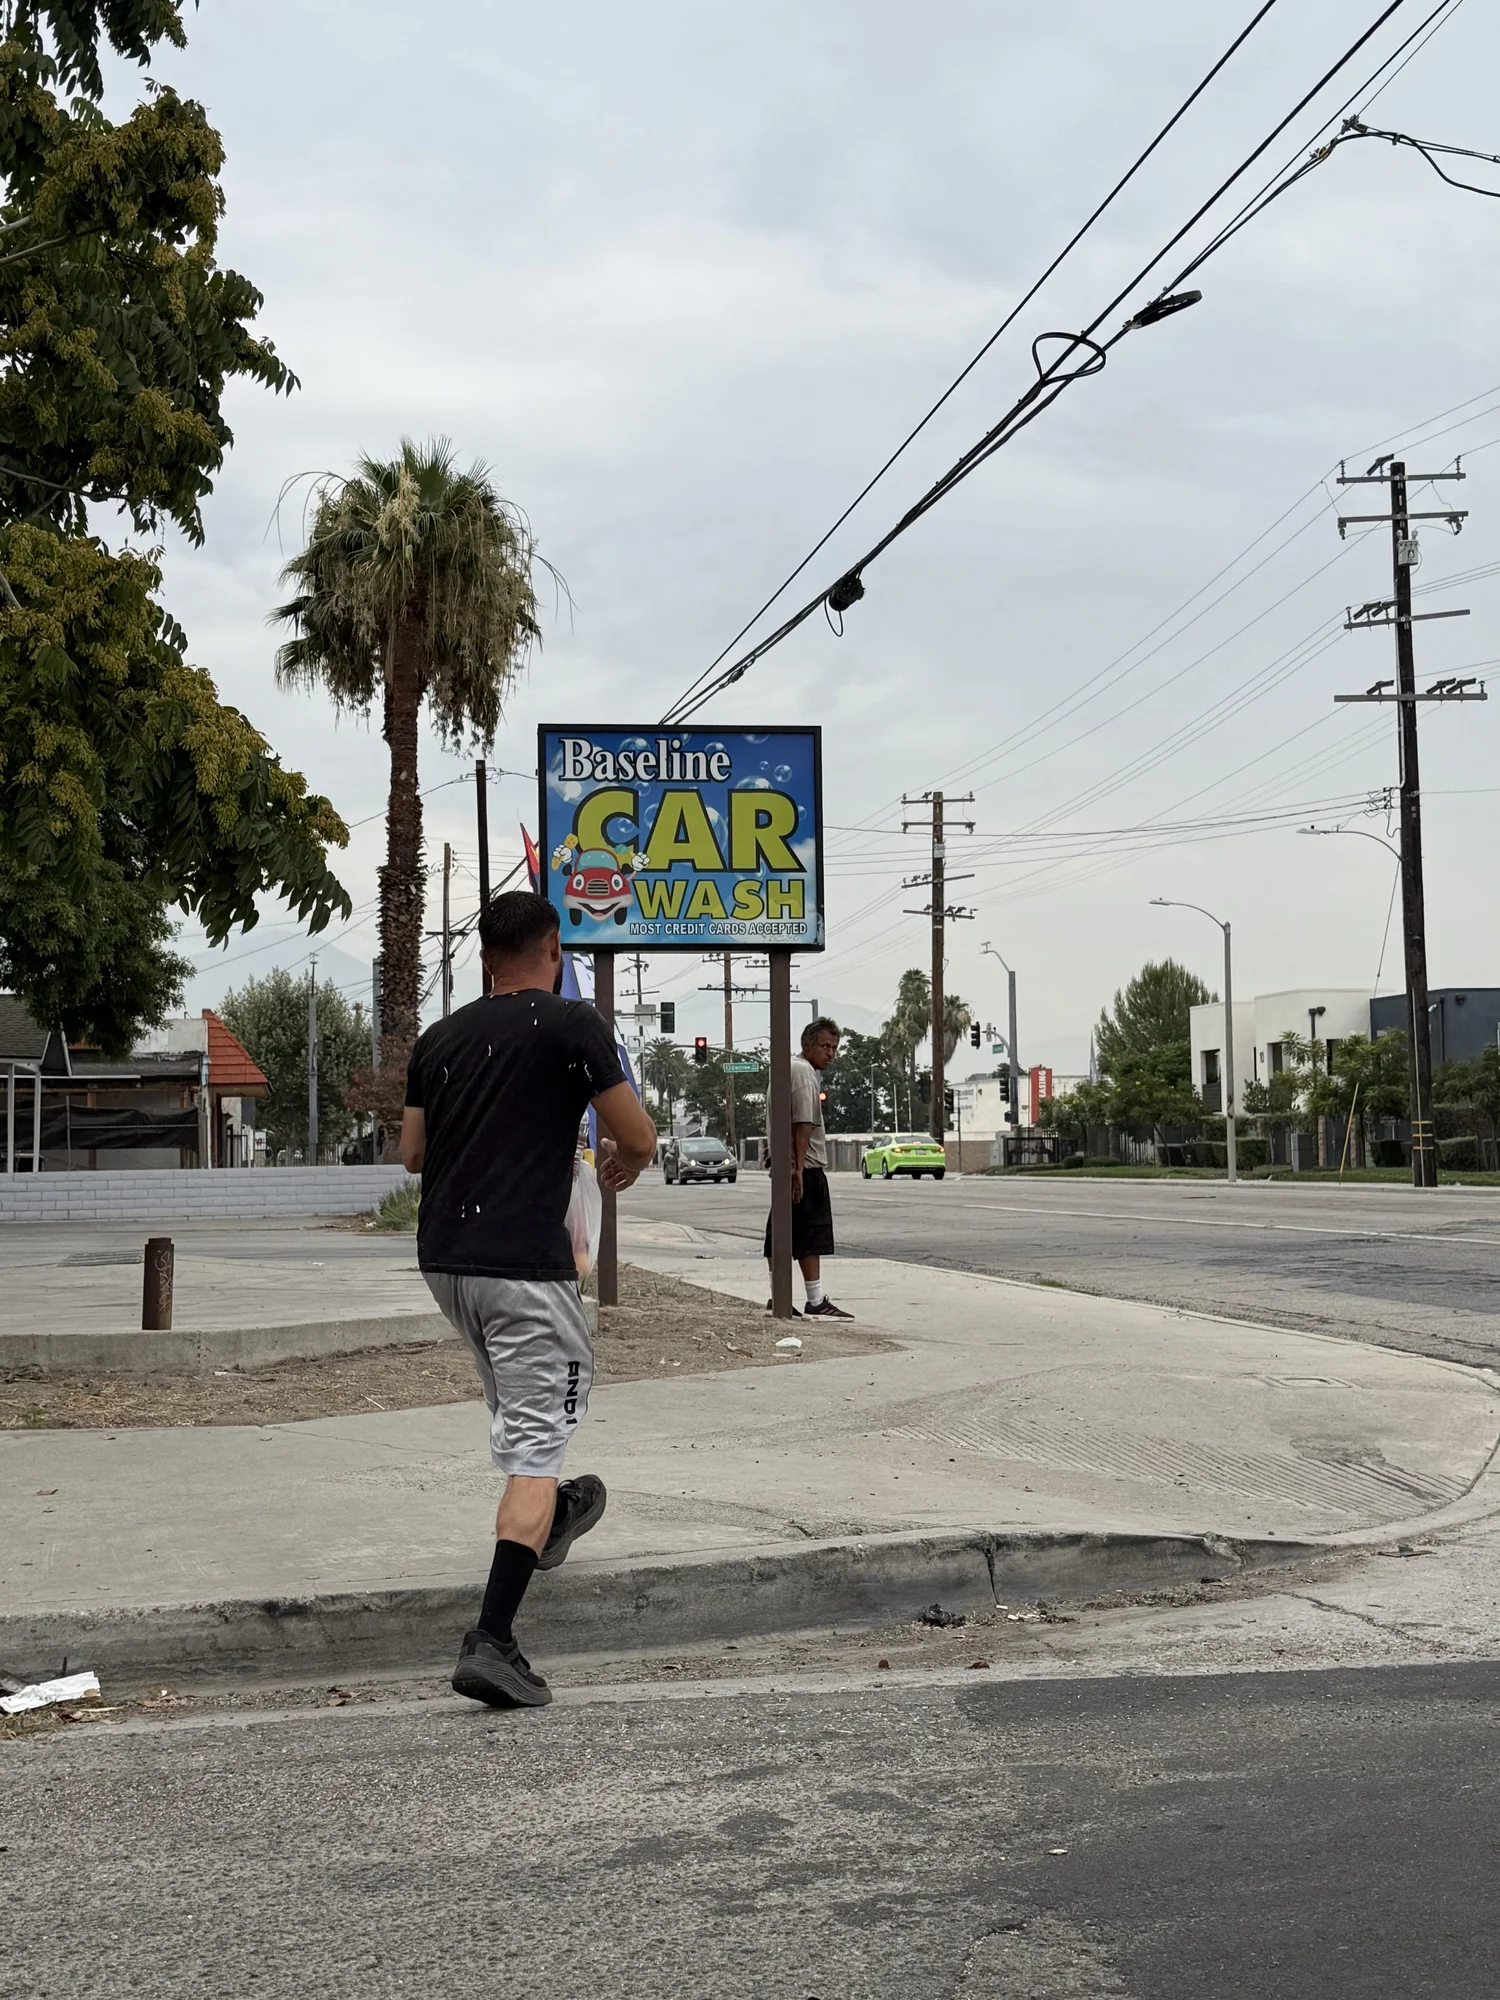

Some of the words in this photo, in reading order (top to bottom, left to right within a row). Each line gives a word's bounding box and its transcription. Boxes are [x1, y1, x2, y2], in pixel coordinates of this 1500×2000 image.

[560, 738, 731, 782] Baseline
[573, 787, 807, 872] CAR
[634, 880, 805, 920] WASH
[630, 923, 661, 935] MOST
[664, 923, 706, 935] CREDIT
[708, 923, 746, 935] CARDS
[748, 923, 807, 935] ACCEPTED
[564, 1361, 580, 1424] AND1
